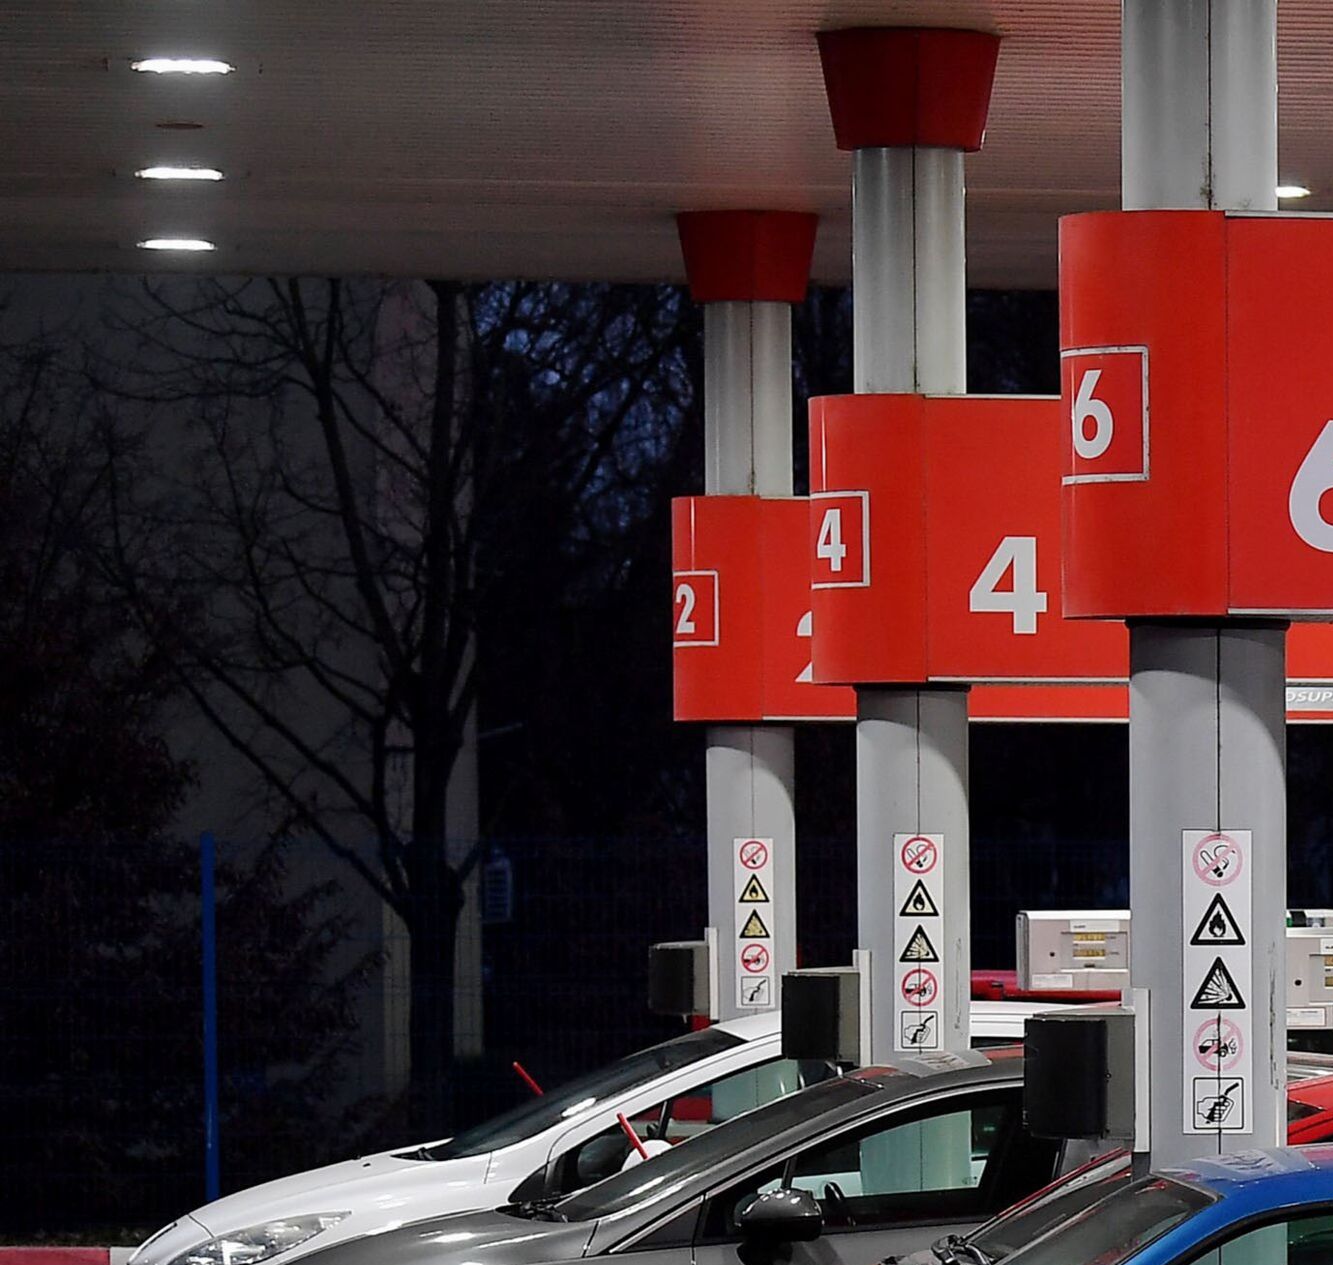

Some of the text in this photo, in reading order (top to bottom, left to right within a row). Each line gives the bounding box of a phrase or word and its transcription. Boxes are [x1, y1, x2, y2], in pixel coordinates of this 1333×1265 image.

[1070, 369, 1114, 467] 6
[816, 508, 847, 572] 4
[675, 583, 696, 634] 2
[969, 536, 1048, 635] 4
